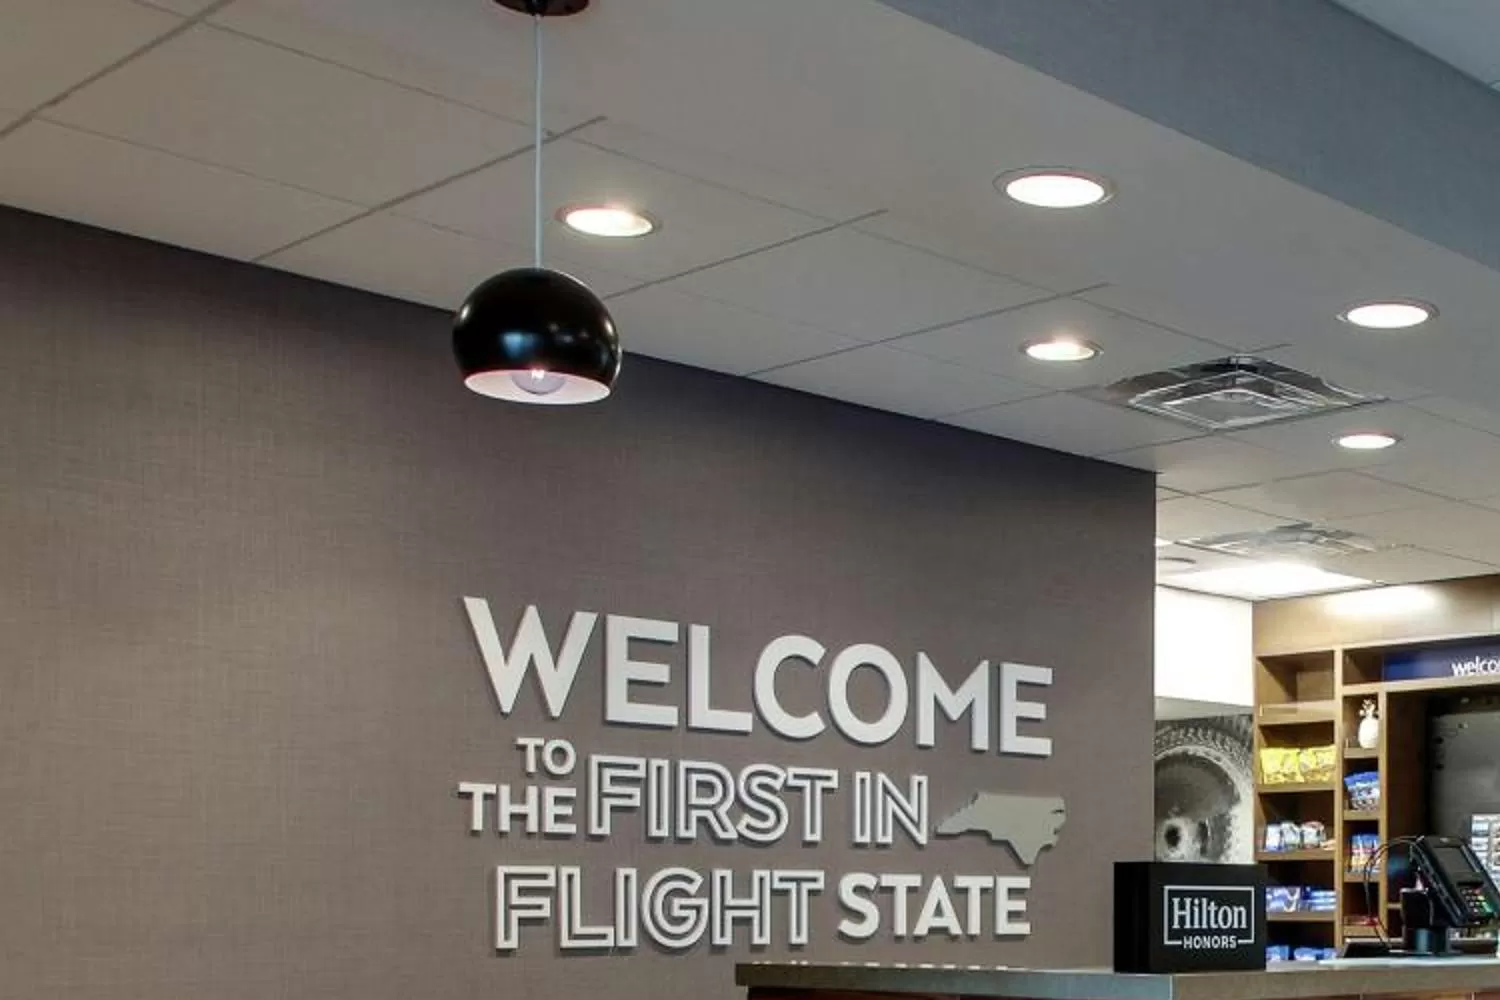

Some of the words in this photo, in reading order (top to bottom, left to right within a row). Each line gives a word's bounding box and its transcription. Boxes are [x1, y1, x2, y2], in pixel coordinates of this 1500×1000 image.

[463, 596, 1053, 755] WELCOME
[516, 738, 576, 775] TO
[458, 782, 577, 834] THE
[588, 754, 839, 843] FIRST
[853, 771, 928, 846] IN
[496, 866, 825, 949] FLIGHT
[837, 872, 1031, 938] STATE
[1171, 897, 1248, 929] Hilton
[1183, 935, 1237, 949] HONORS
